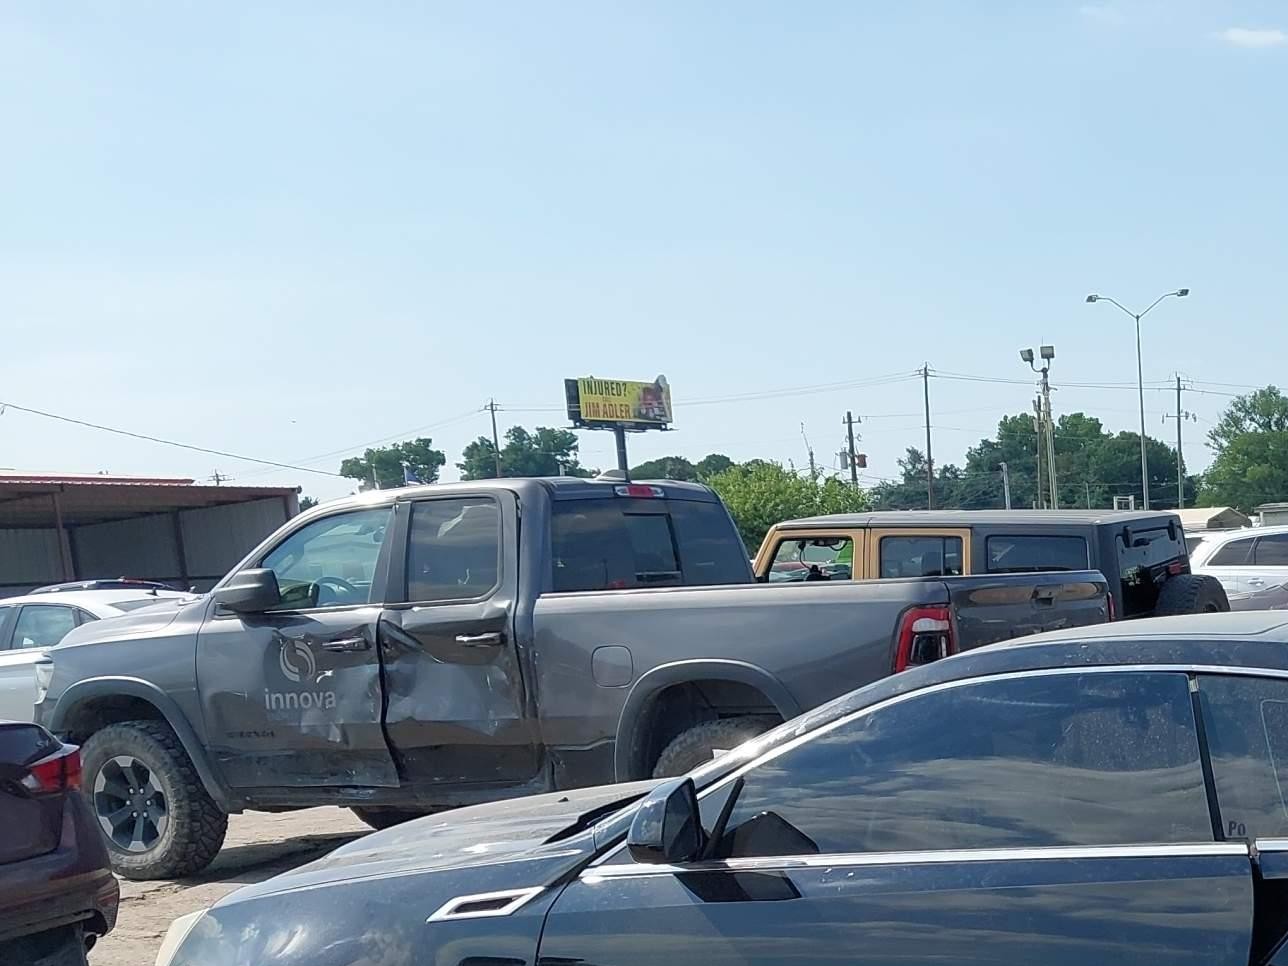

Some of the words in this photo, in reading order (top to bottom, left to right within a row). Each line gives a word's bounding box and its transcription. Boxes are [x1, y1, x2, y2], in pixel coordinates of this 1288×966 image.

[583, 380, 627, 397] INJURED?
[585, 402, 601, 418] JIM
[602, 403, 631, 419] ADLER
[265, 688, 336, 709] innova
